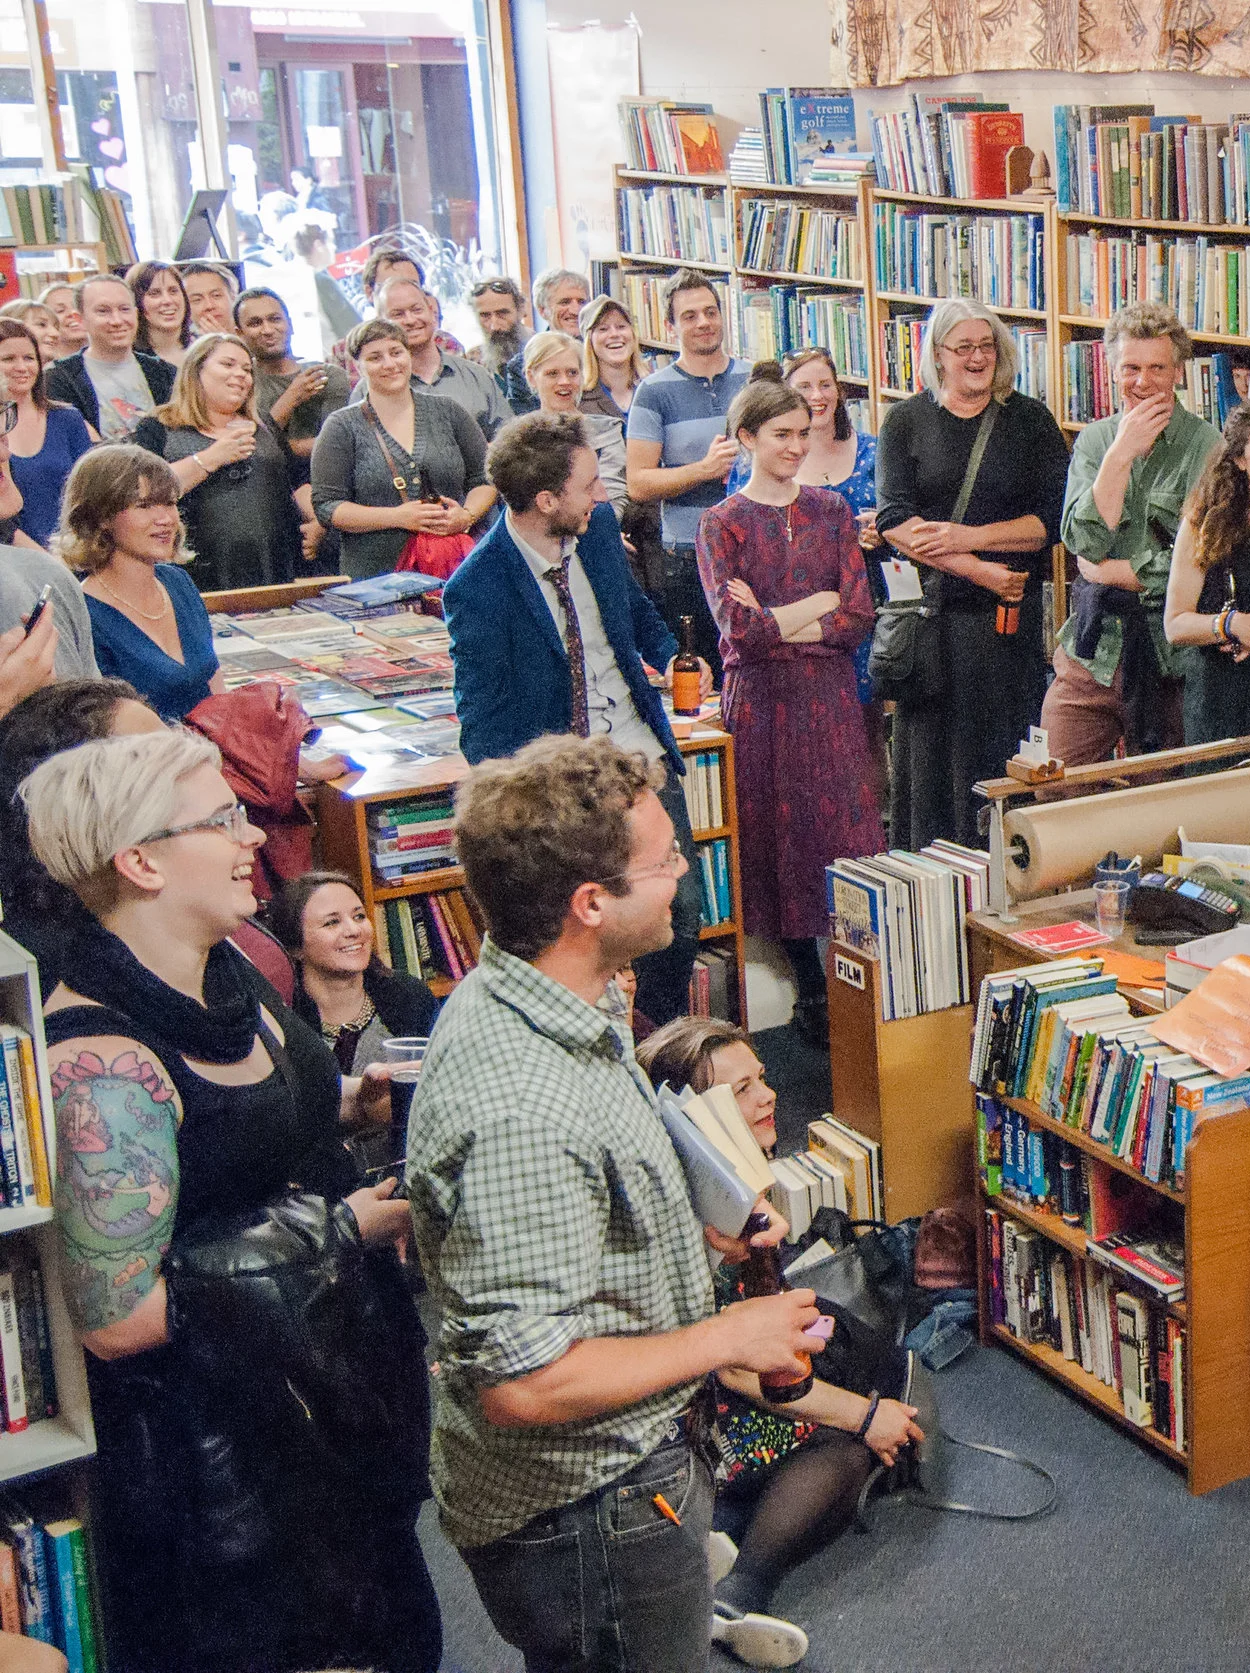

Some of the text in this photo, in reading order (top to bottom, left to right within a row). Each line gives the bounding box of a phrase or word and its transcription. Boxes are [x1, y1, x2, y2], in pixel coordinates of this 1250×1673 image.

[800, 102, 850, 115] eXtreme
[801, 115, 825, 130] golf
[838, 960, 862, 985] FILM
[1207, 1084, 1250, 1101] New Zealand
[1004, 1123, 1014, 1166] England
[1017, 1129, 1026, 1175] Germany
[1033, 1135, 1041, 1178] Morocco
[6, 1151, 18, 1183] TRITON
